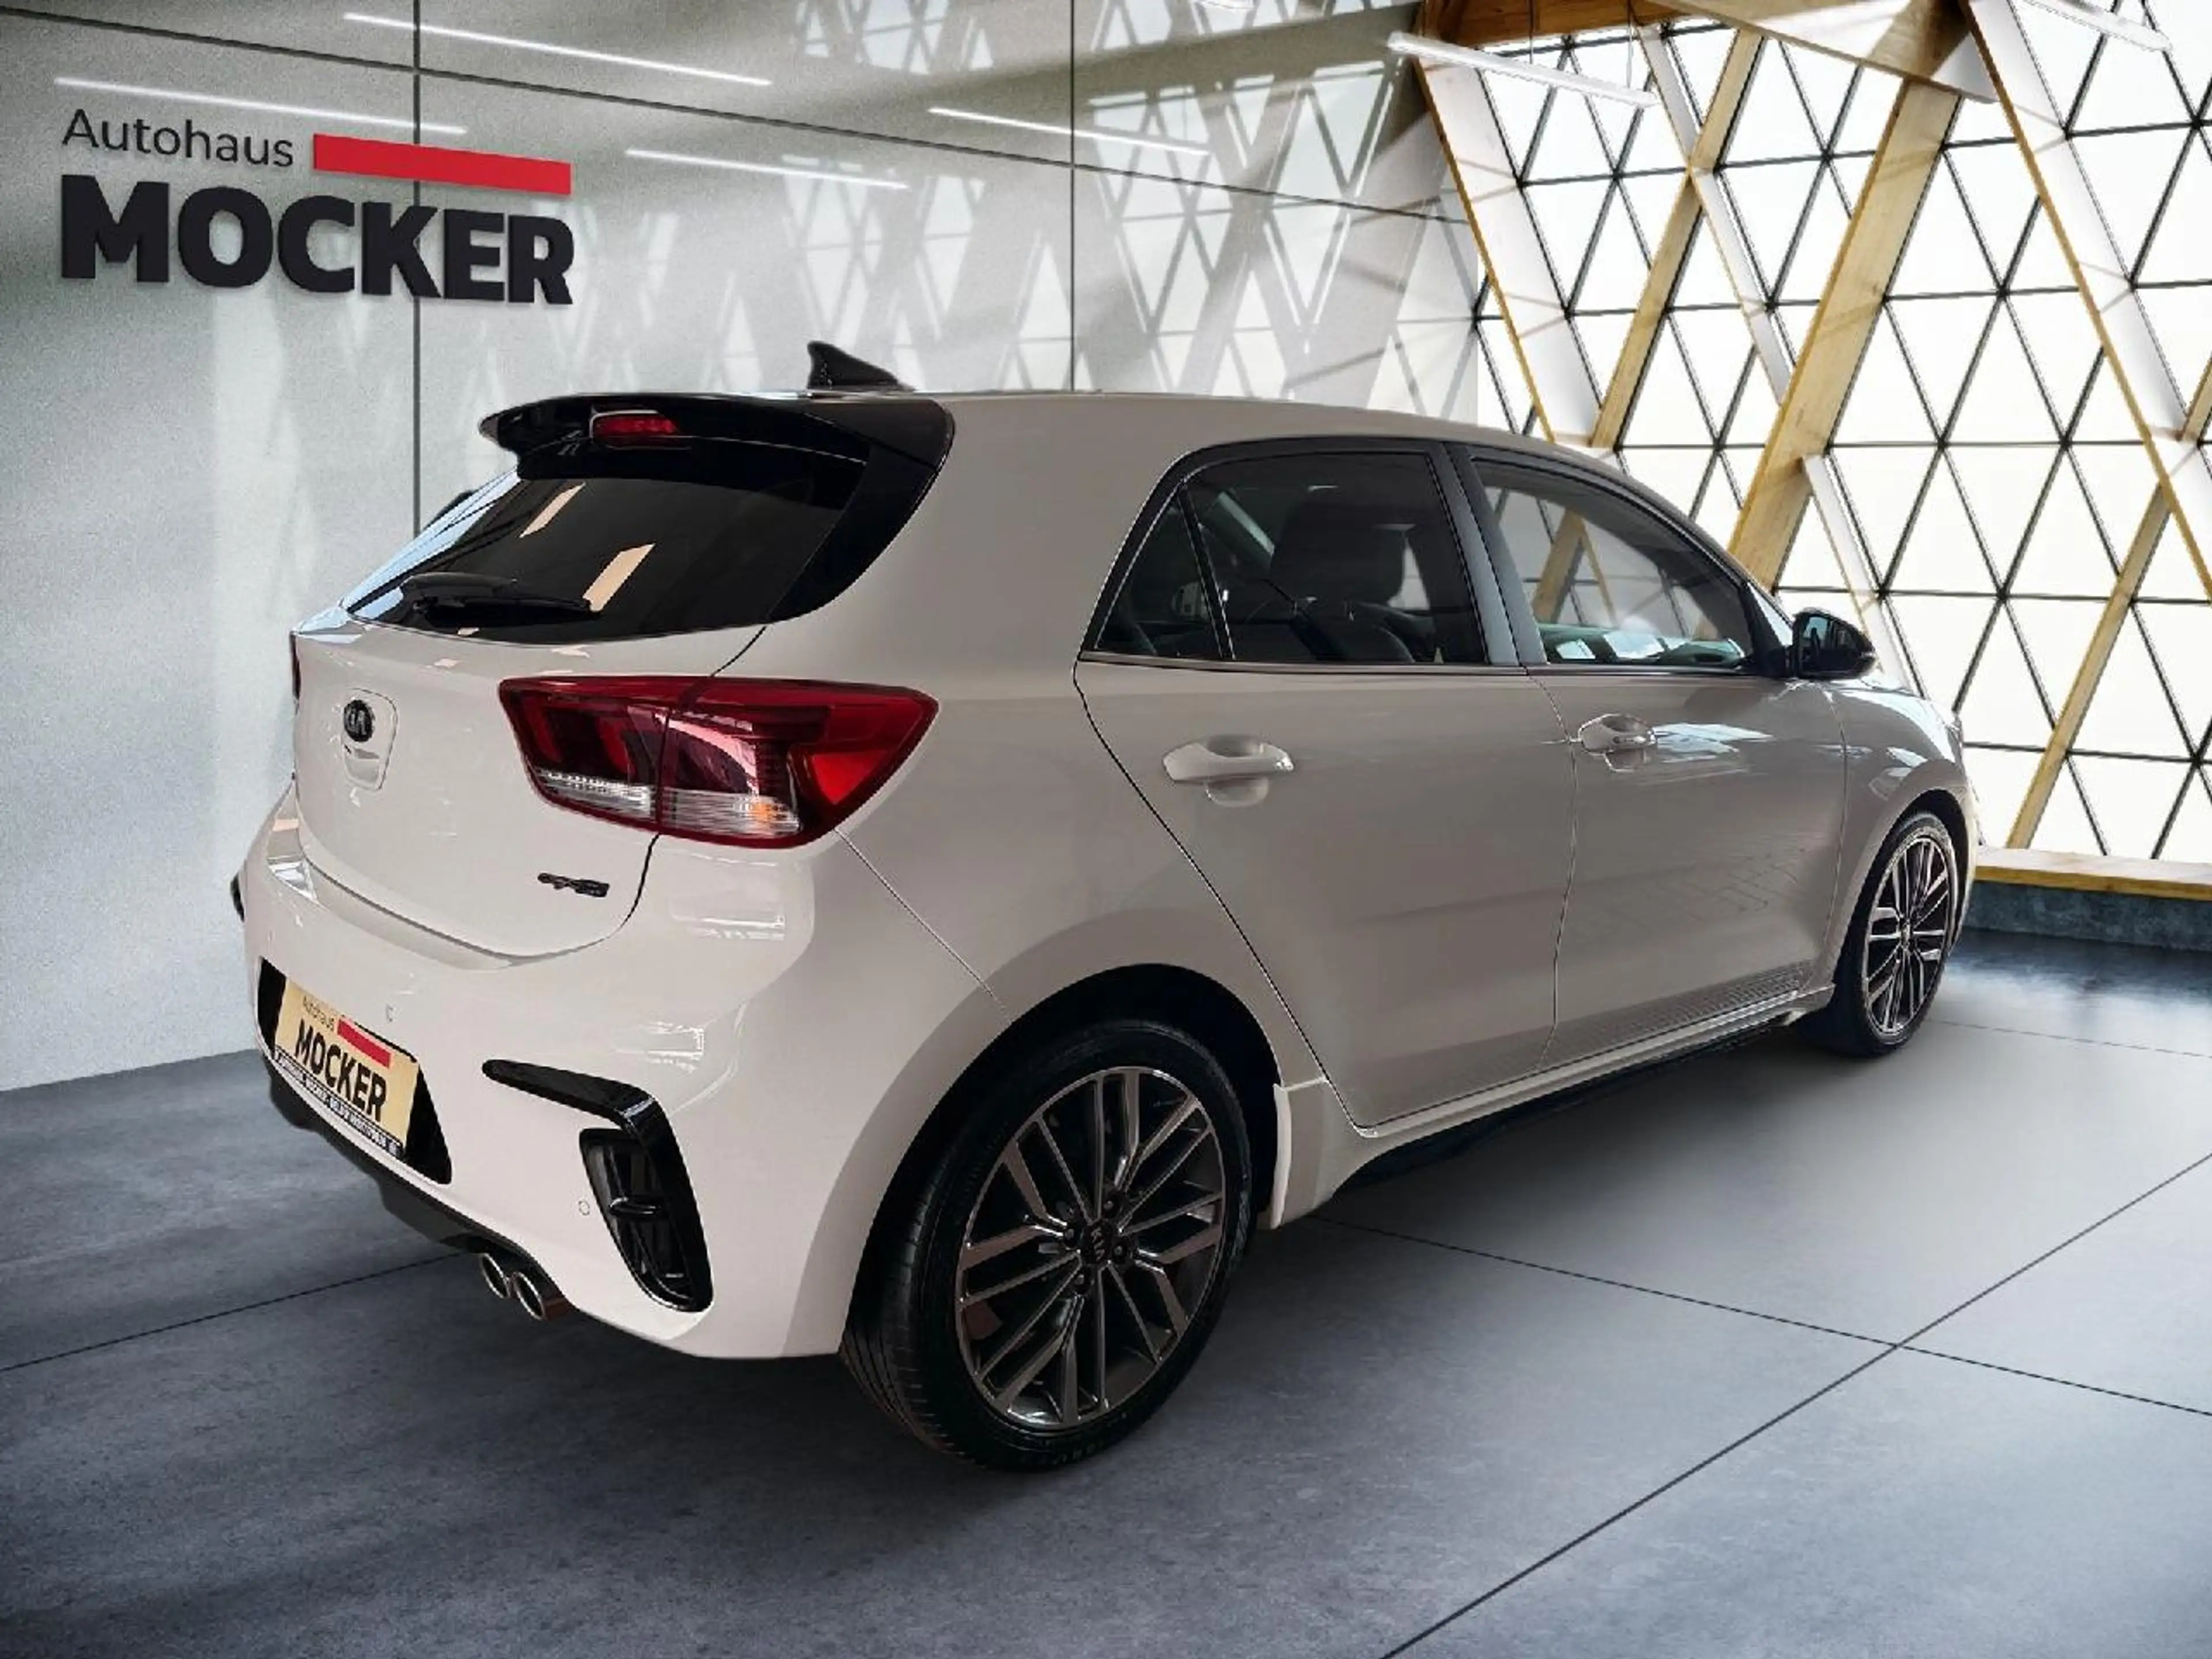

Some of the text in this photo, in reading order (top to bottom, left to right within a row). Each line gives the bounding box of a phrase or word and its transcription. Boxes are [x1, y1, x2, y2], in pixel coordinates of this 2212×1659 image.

[63, 109, 293, 168] Autohaus
[61, 174, 575, 305] MOCKER
[295, 1019, 387, 1122] MOCKER
